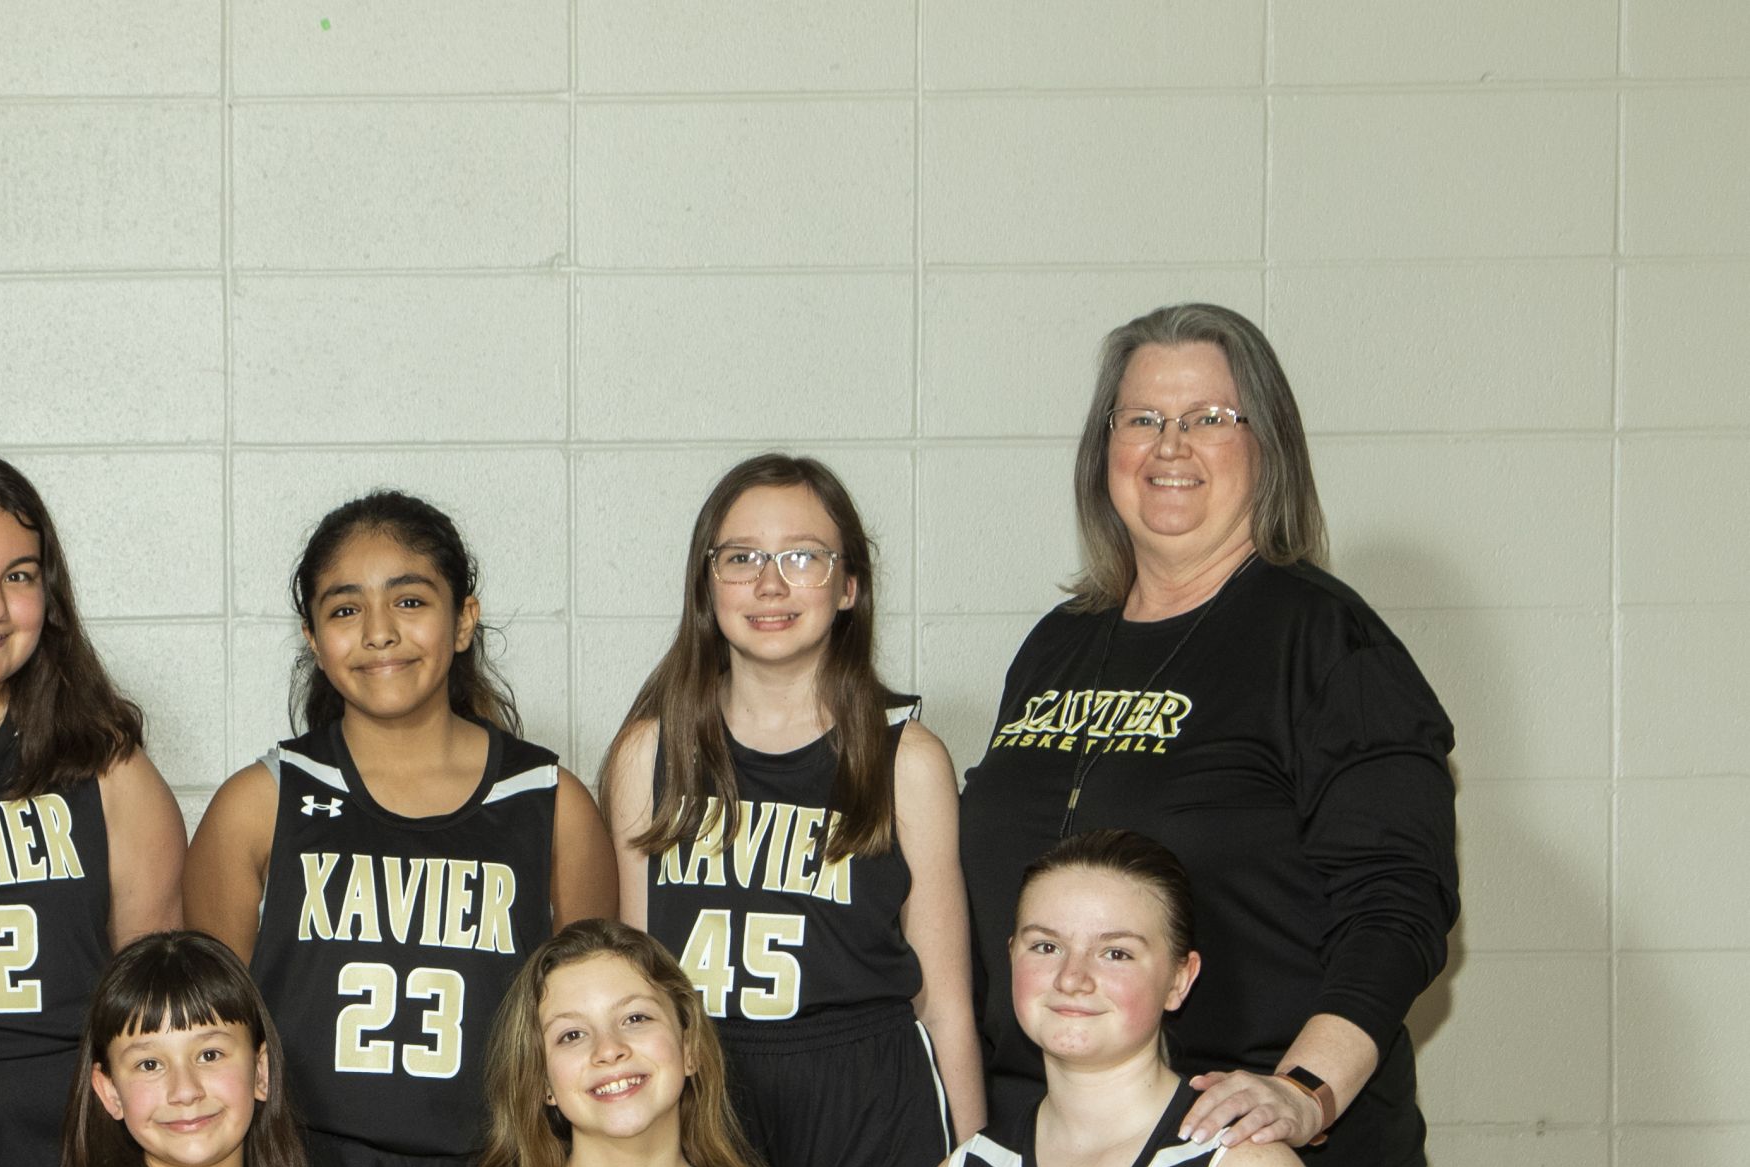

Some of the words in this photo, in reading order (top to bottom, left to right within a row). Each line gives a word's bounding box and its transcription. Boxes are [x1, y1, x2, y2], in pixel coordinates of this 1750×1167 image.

[1000, 690, 1192, 738] XAVIER
[298, 853, 516, 954] XAVIER
[679, 909, 805, 1020] 45
[335, 962, 465, 1079] 23
